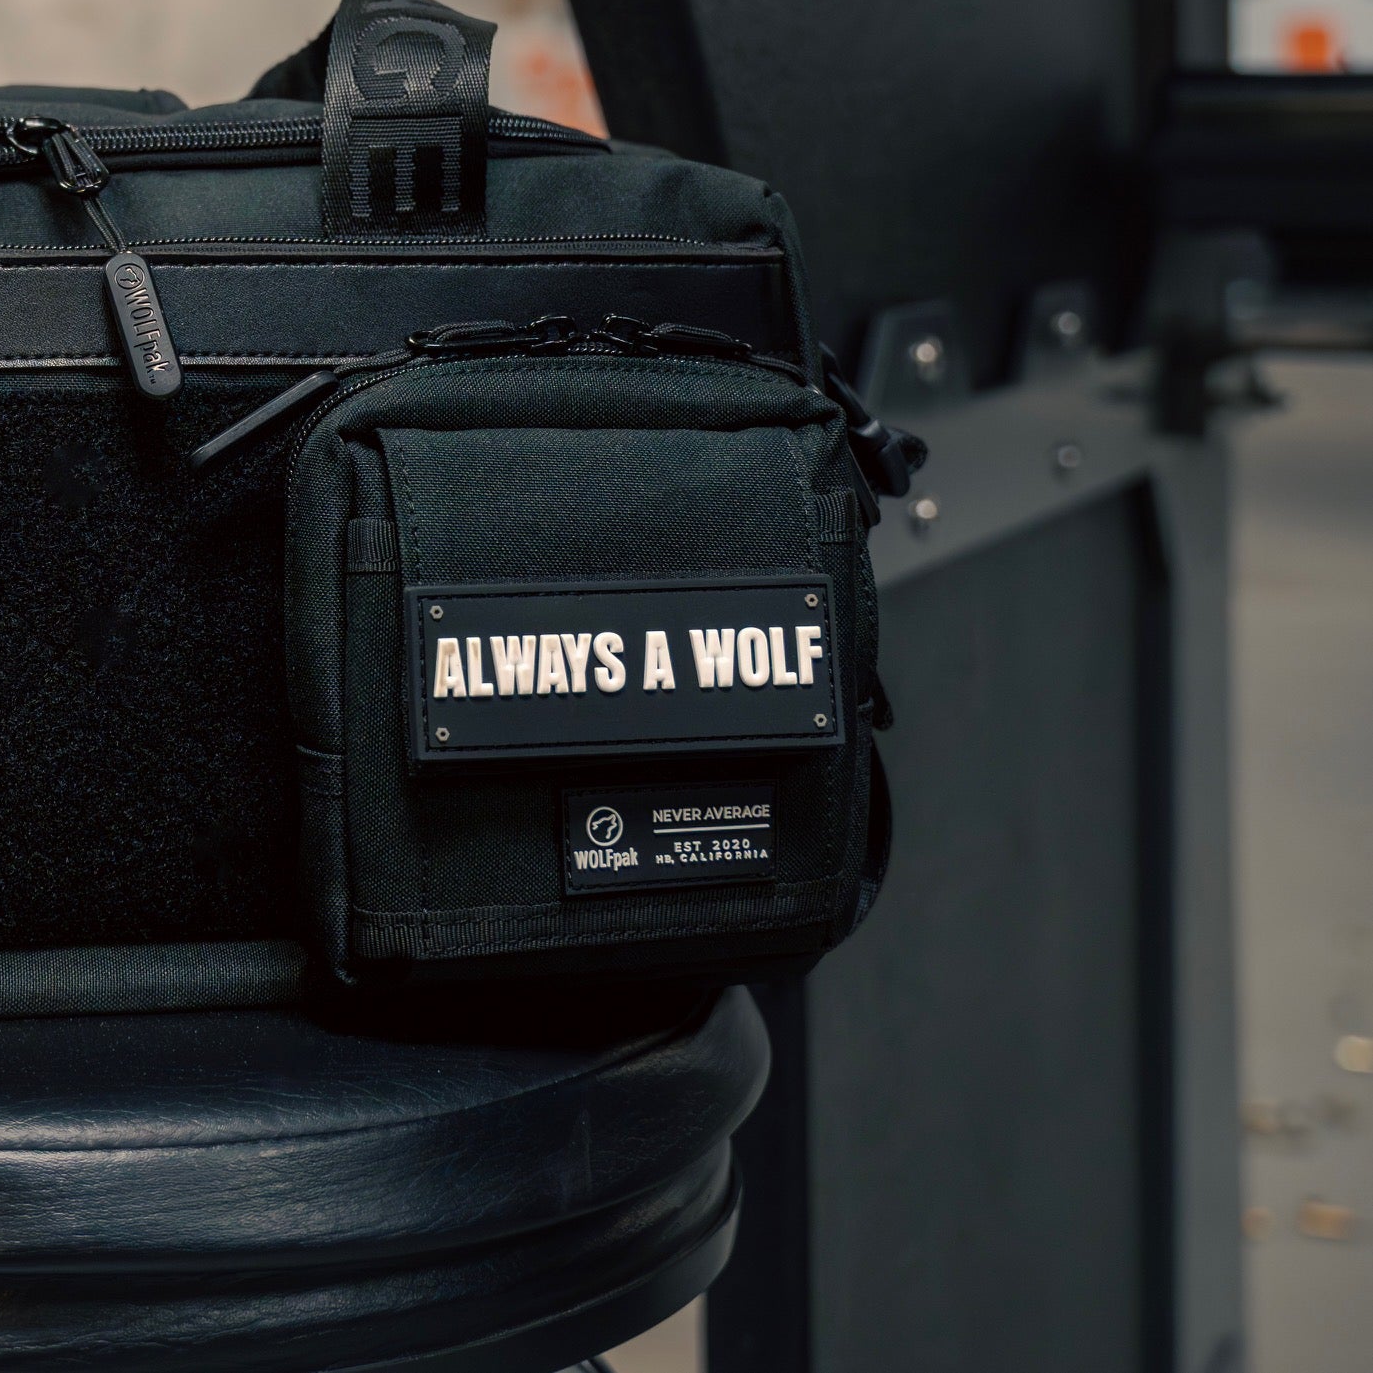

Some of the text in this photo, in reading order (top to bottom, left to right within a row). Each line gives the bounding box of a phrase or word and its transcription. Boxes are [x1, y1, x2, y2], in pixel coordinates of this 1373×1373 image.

[433, 625, 823, 698] ALWAYS A WOLF
[652, 804, 771, 823] NEVER AVERAGE
[673, 838, 751, 854] EST 2020
[573, 847, 639, 872] WOLFpak
[655, 848, 769, 866] HB, CALIFORNIA
